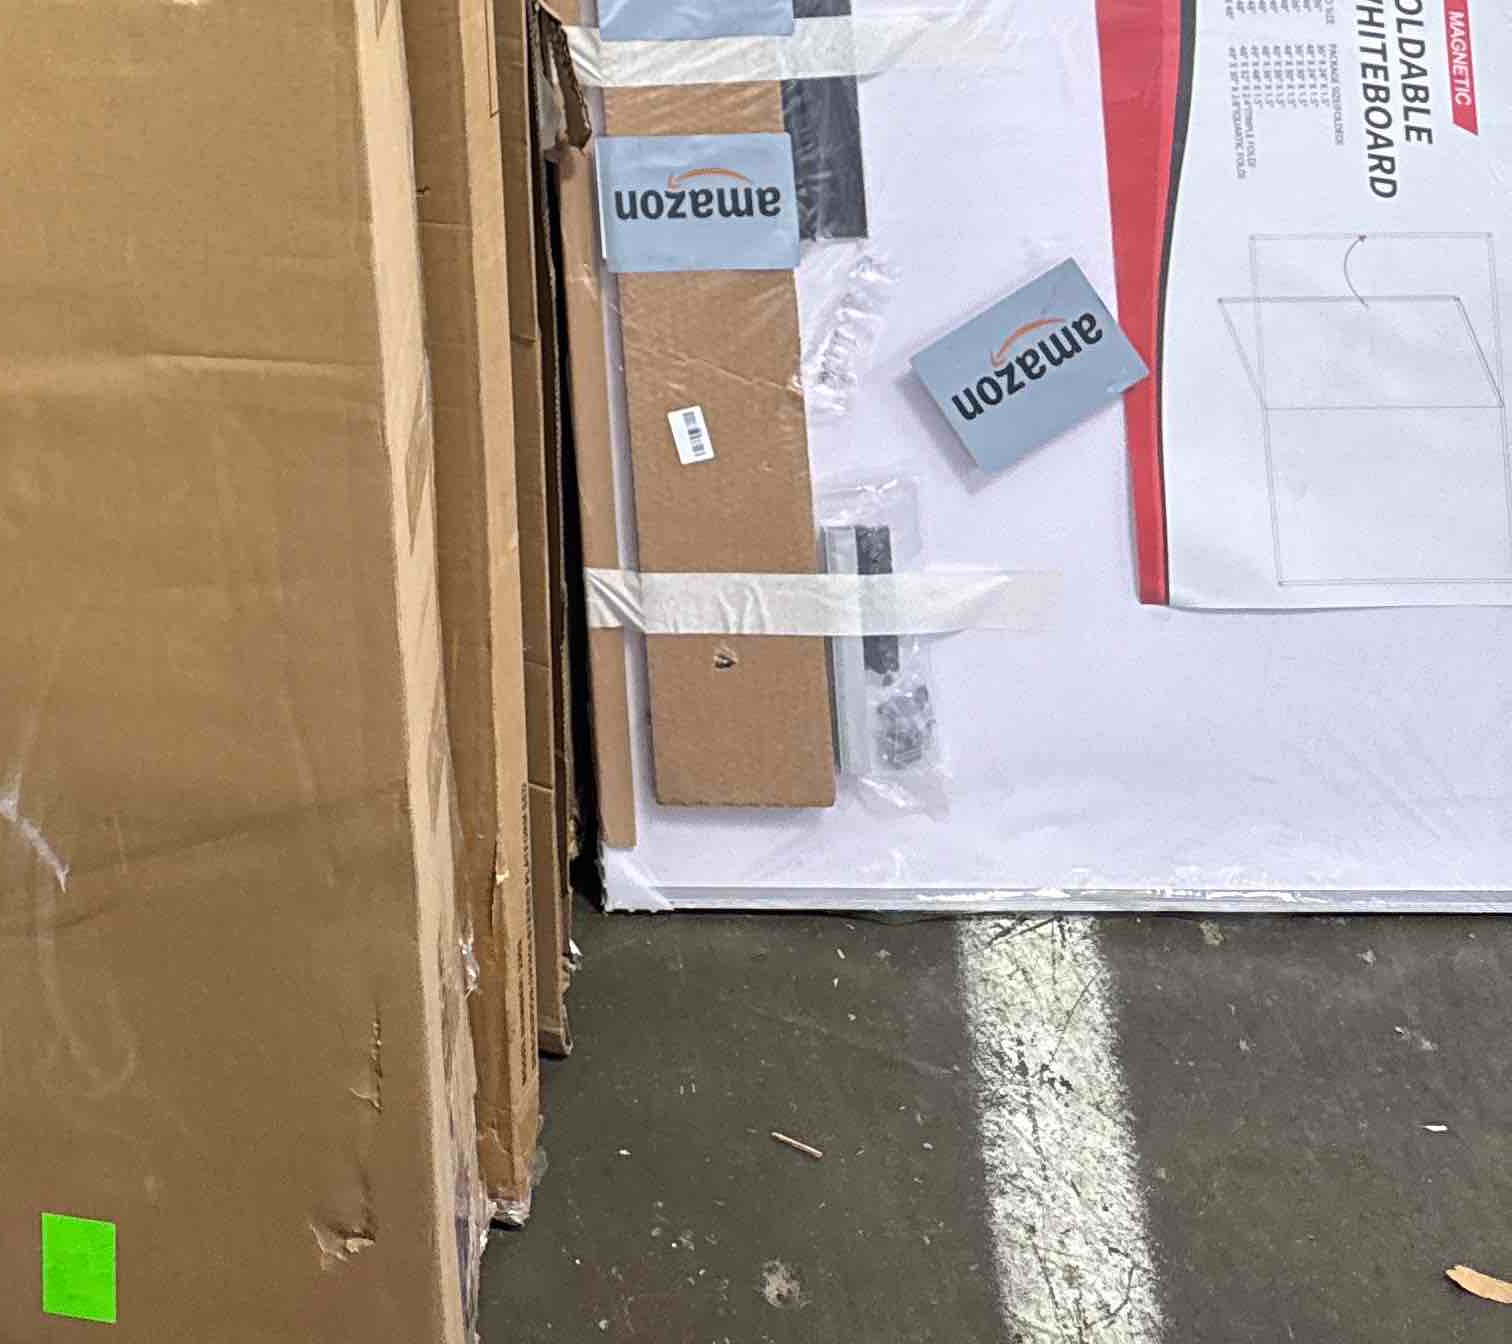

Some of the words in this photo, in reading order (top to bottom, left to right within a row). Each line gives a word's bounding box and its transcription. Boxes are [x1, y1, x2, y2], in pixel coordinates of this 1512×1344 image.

[1448, 10, 1472, 107] MAGNETIC
[614, 186, 781, 220] amazon
[951, 312, 1103, 421] amazon
